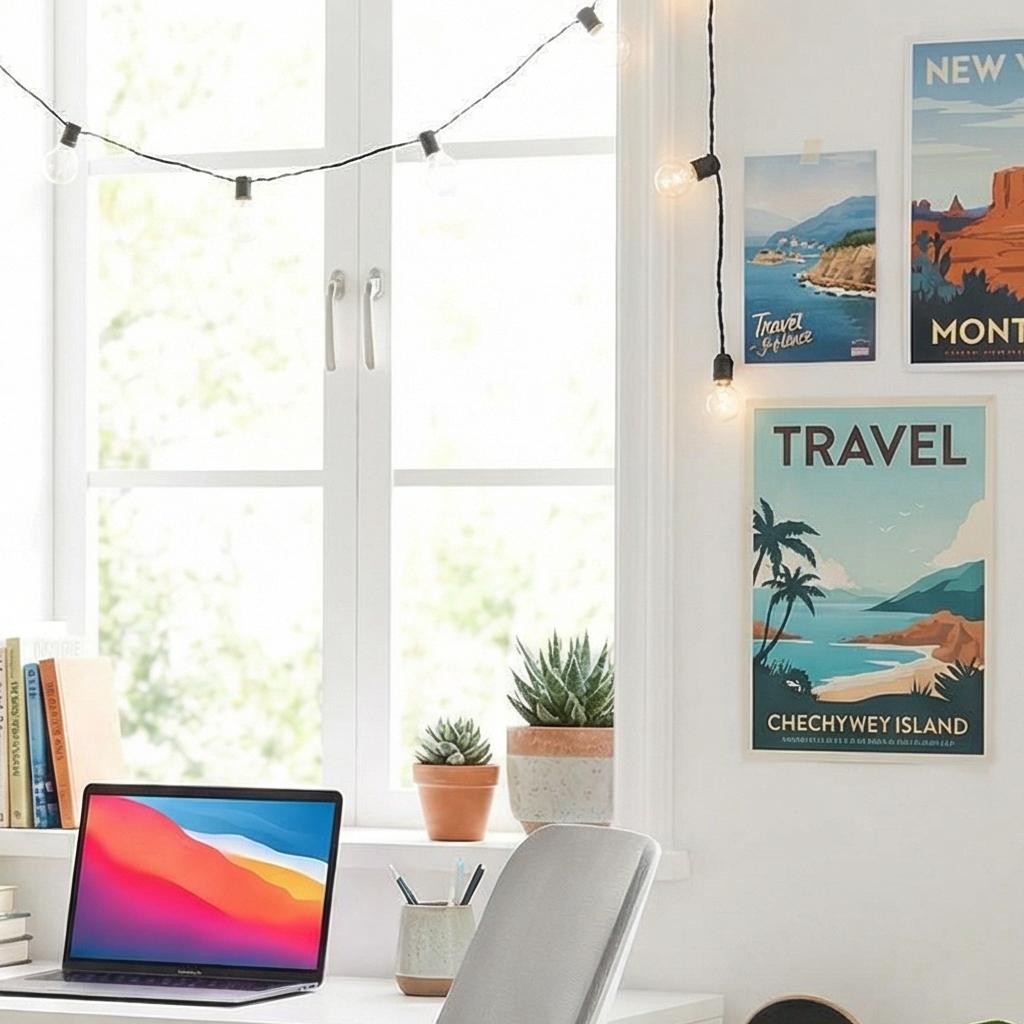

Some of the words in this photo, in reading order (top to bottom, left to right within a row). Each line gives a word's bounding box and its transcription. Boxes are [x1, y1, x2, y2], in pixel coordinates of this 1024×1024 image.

[926, 53, 1007, 86] NEW
[752, 311, 803, 338] Travel
[932, 317, 1024, 345] MONT
[773, 424, 967, 467] TRAVEL
[767, 714, 891, 733] CHECHYWEY
[895, 716, 969, 735] ISLAND
